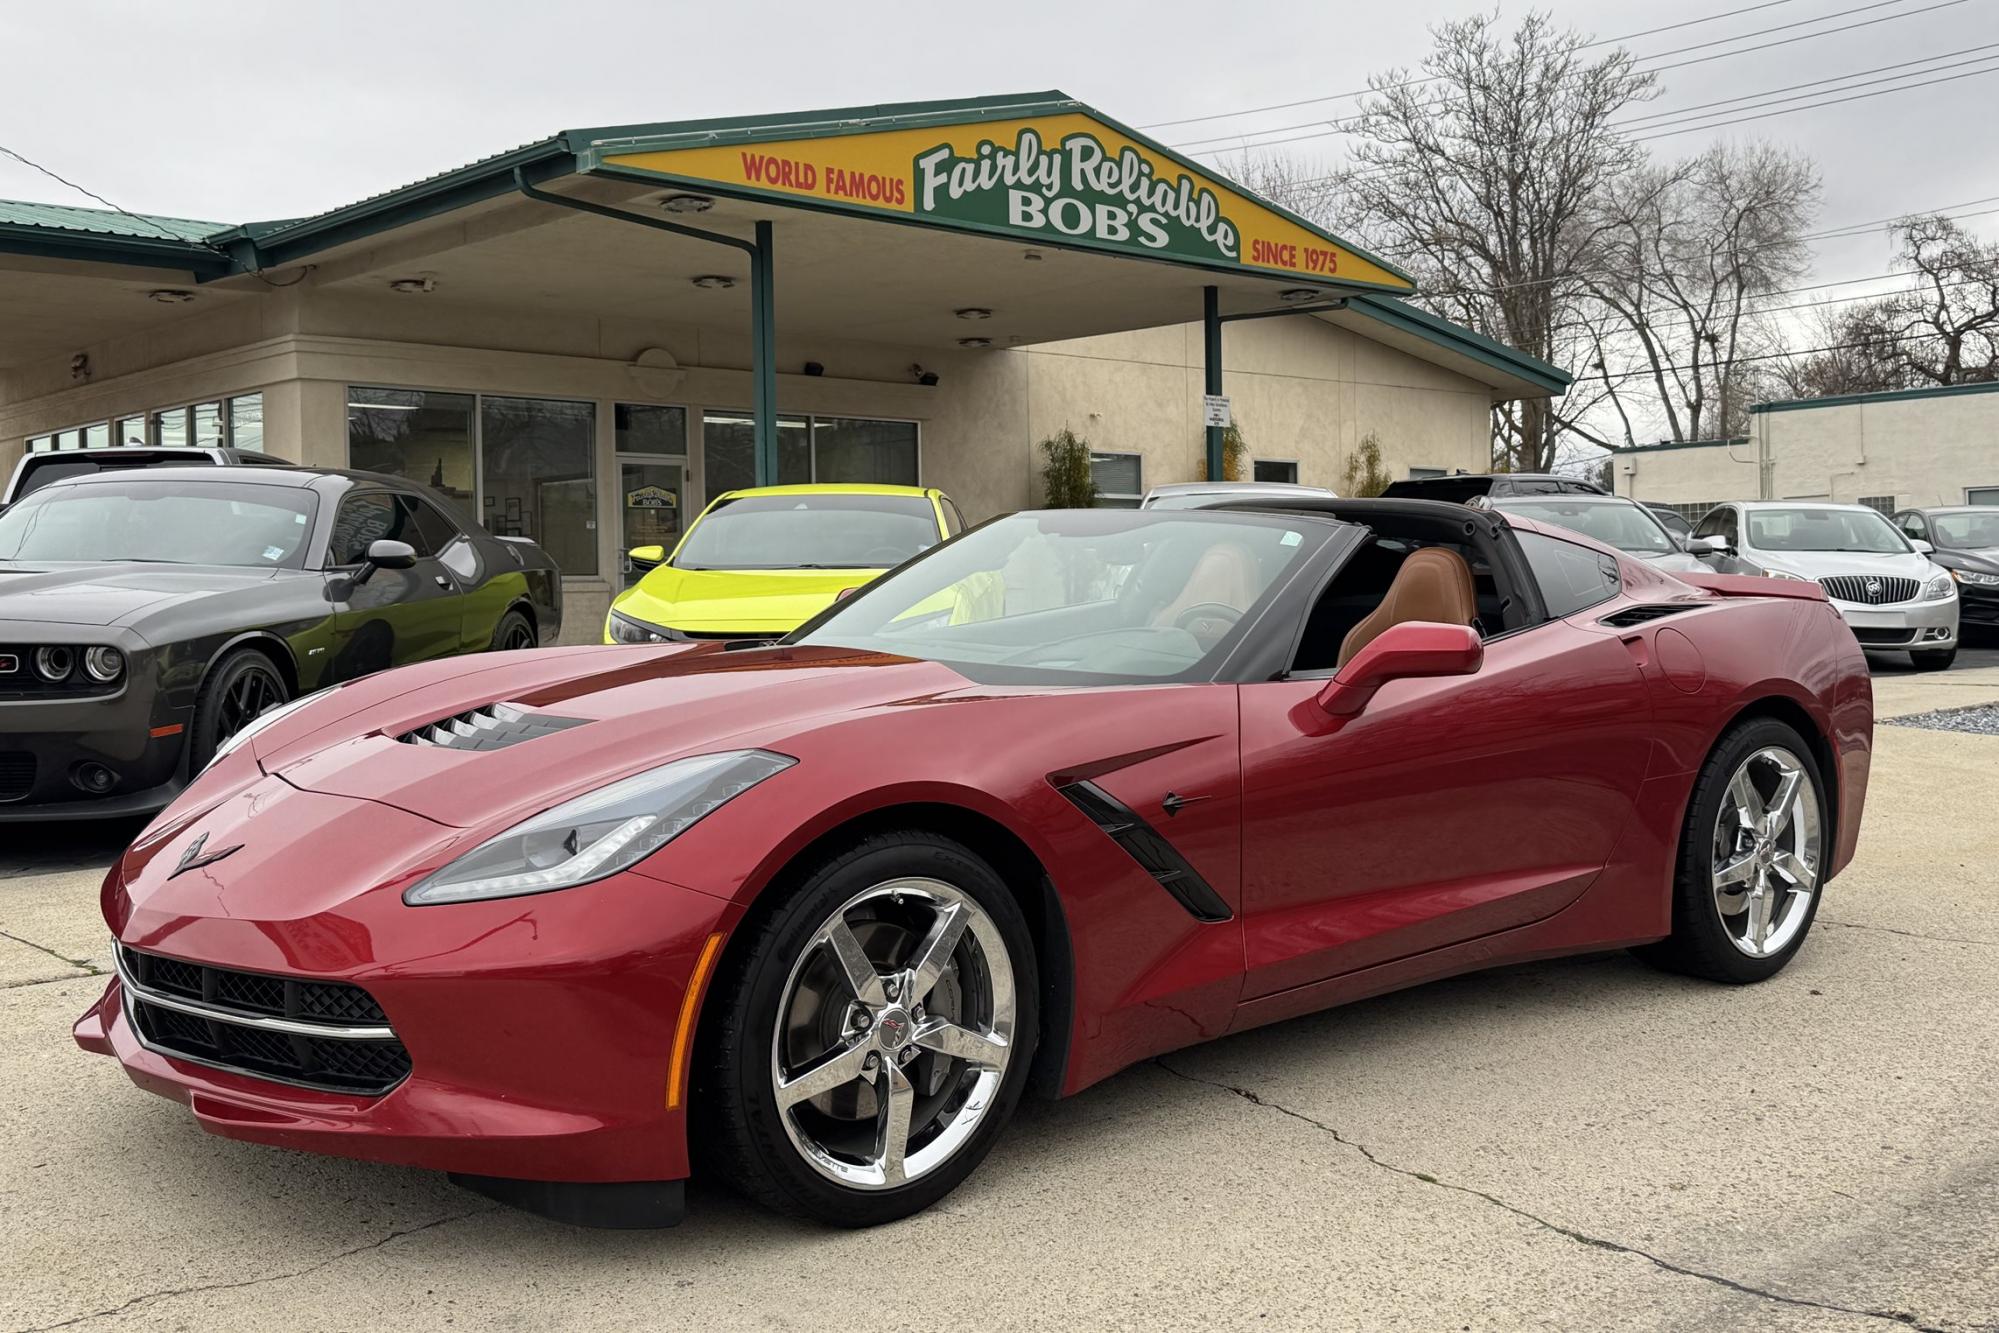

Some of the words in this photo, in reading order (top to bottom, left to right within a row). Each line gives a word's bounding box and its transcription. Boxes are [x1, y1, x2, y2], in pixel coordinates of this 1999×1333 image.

[741, 151, 817, 191] WORLD
[825, 166, 905, 206] FAMOUS
[919, 132, 1062, 212] Fairly
[1064, 136, 1238, 258] Reliable
[1008, 188, 1170, 249] BOB'S
[1252, 238, 1297, 268] SINCE
[1303, 247, 1338, 274] 1975
